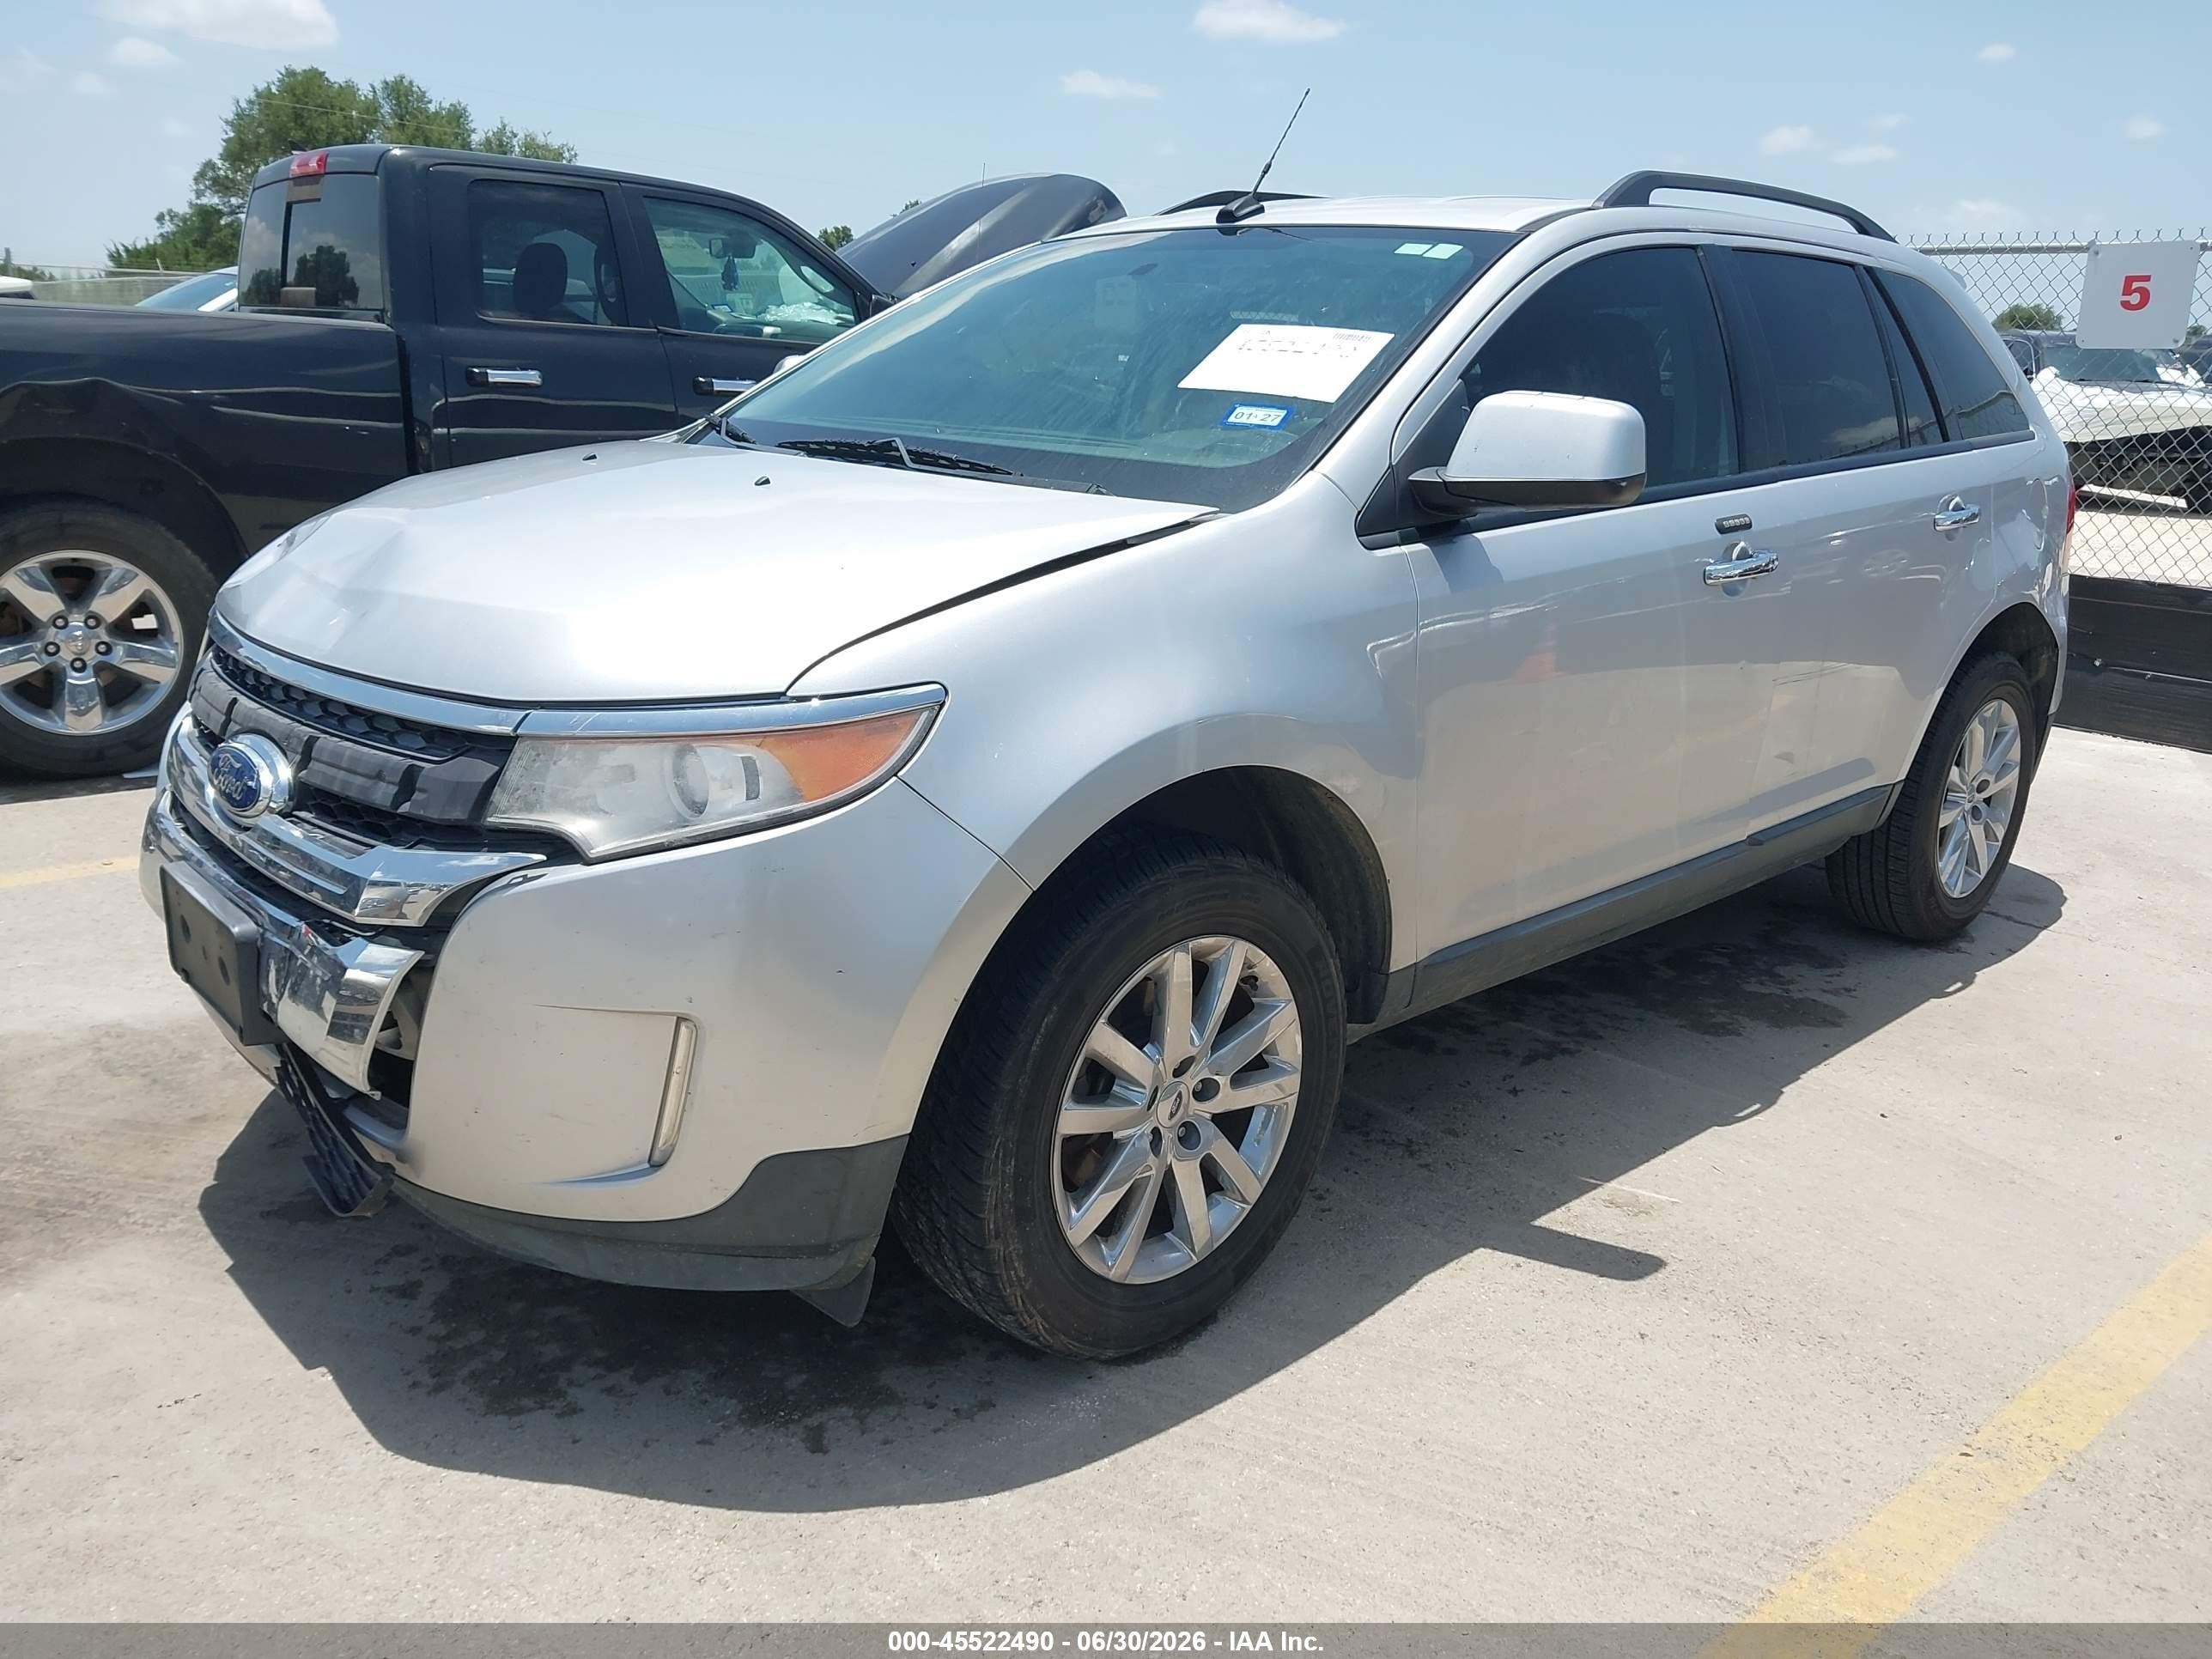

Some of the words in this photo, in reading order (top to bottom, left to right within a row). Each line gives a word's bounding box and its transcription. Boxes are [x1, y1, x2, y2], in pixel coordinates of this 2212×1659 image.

[2119, 275, 2152, 312] 5
[1234, 411, 1254, 420] 01
[1259, 413, 1282, 422] 27
[213, 752, 258, 800] Ford
